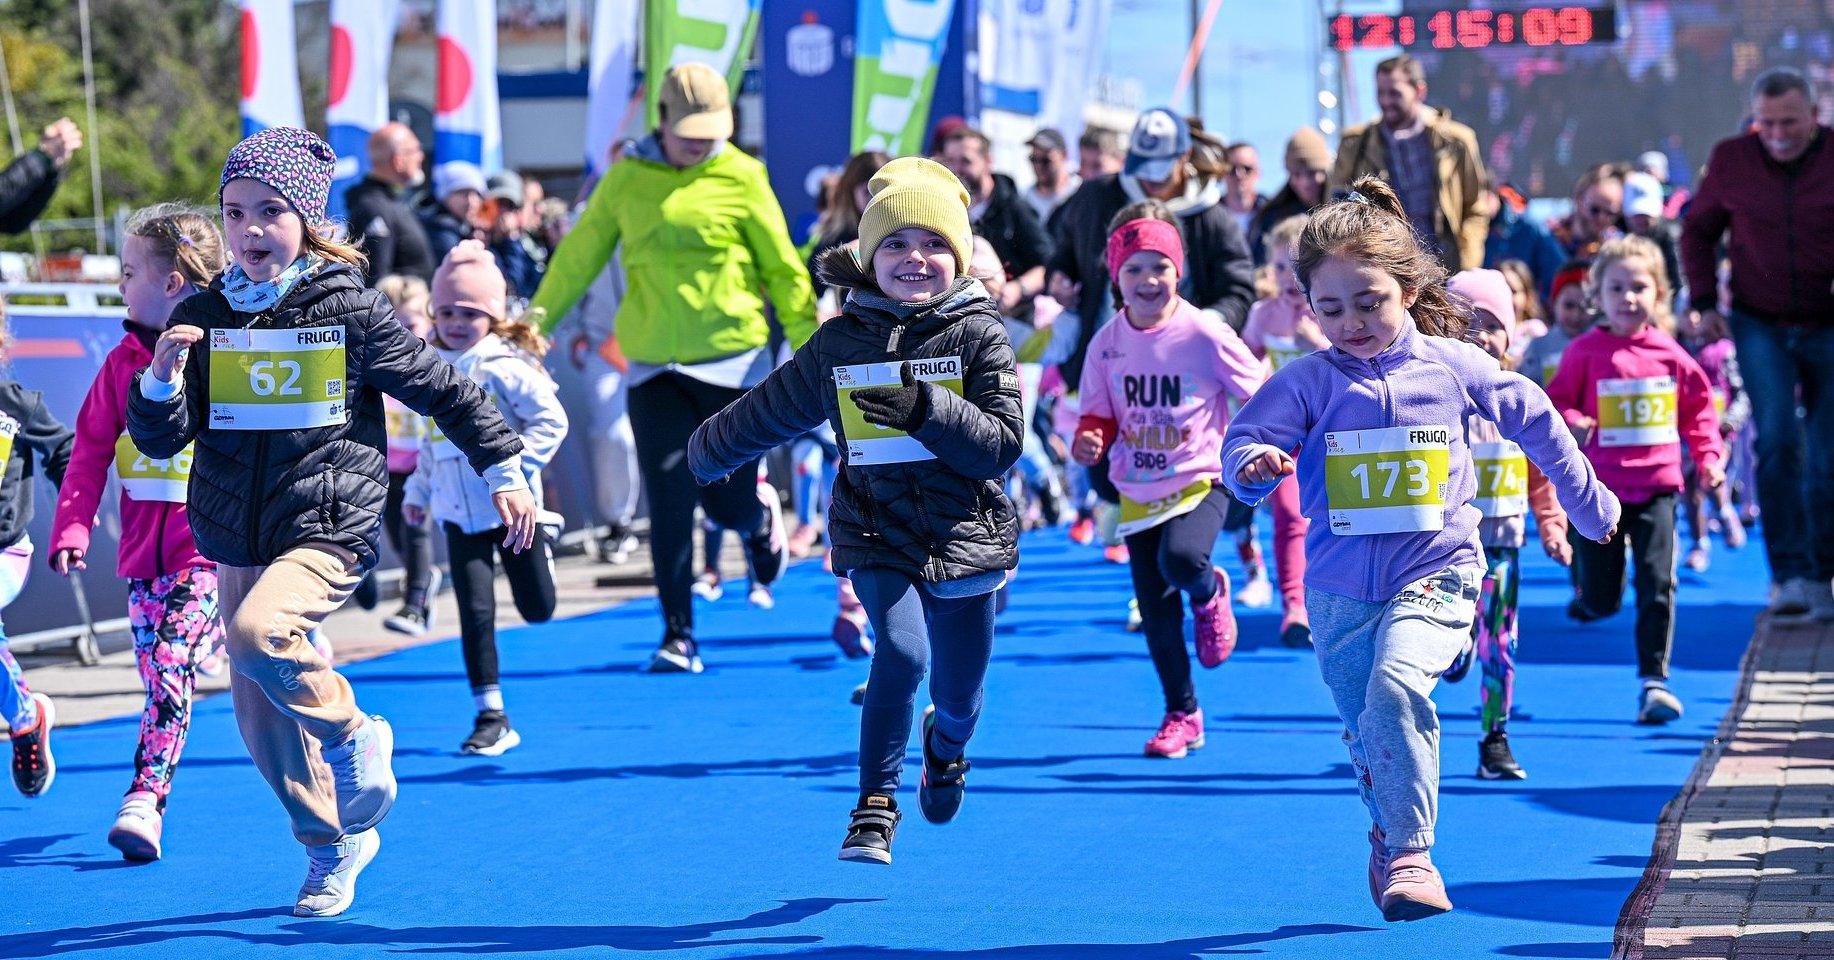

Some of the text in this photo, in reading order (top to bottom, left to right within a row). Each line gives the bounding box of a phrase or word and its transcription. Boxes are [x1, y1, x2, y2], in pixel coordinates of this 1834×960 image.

[1330, 7, 1593, 51] 12:15:09
[297, 330, 341, 344] FRUGO
[250, 360, 303, 397] 62
[912, 361, 957, 376] FRUGO
[1124, 374, 1181, 408] RUN
[1618, 397, 1665, 424] 192
[1122, 425, 1180, 450] WILD
[1409, 430, 1447, 446] FRUGO
[1350, 459, 1430, 500] 173
